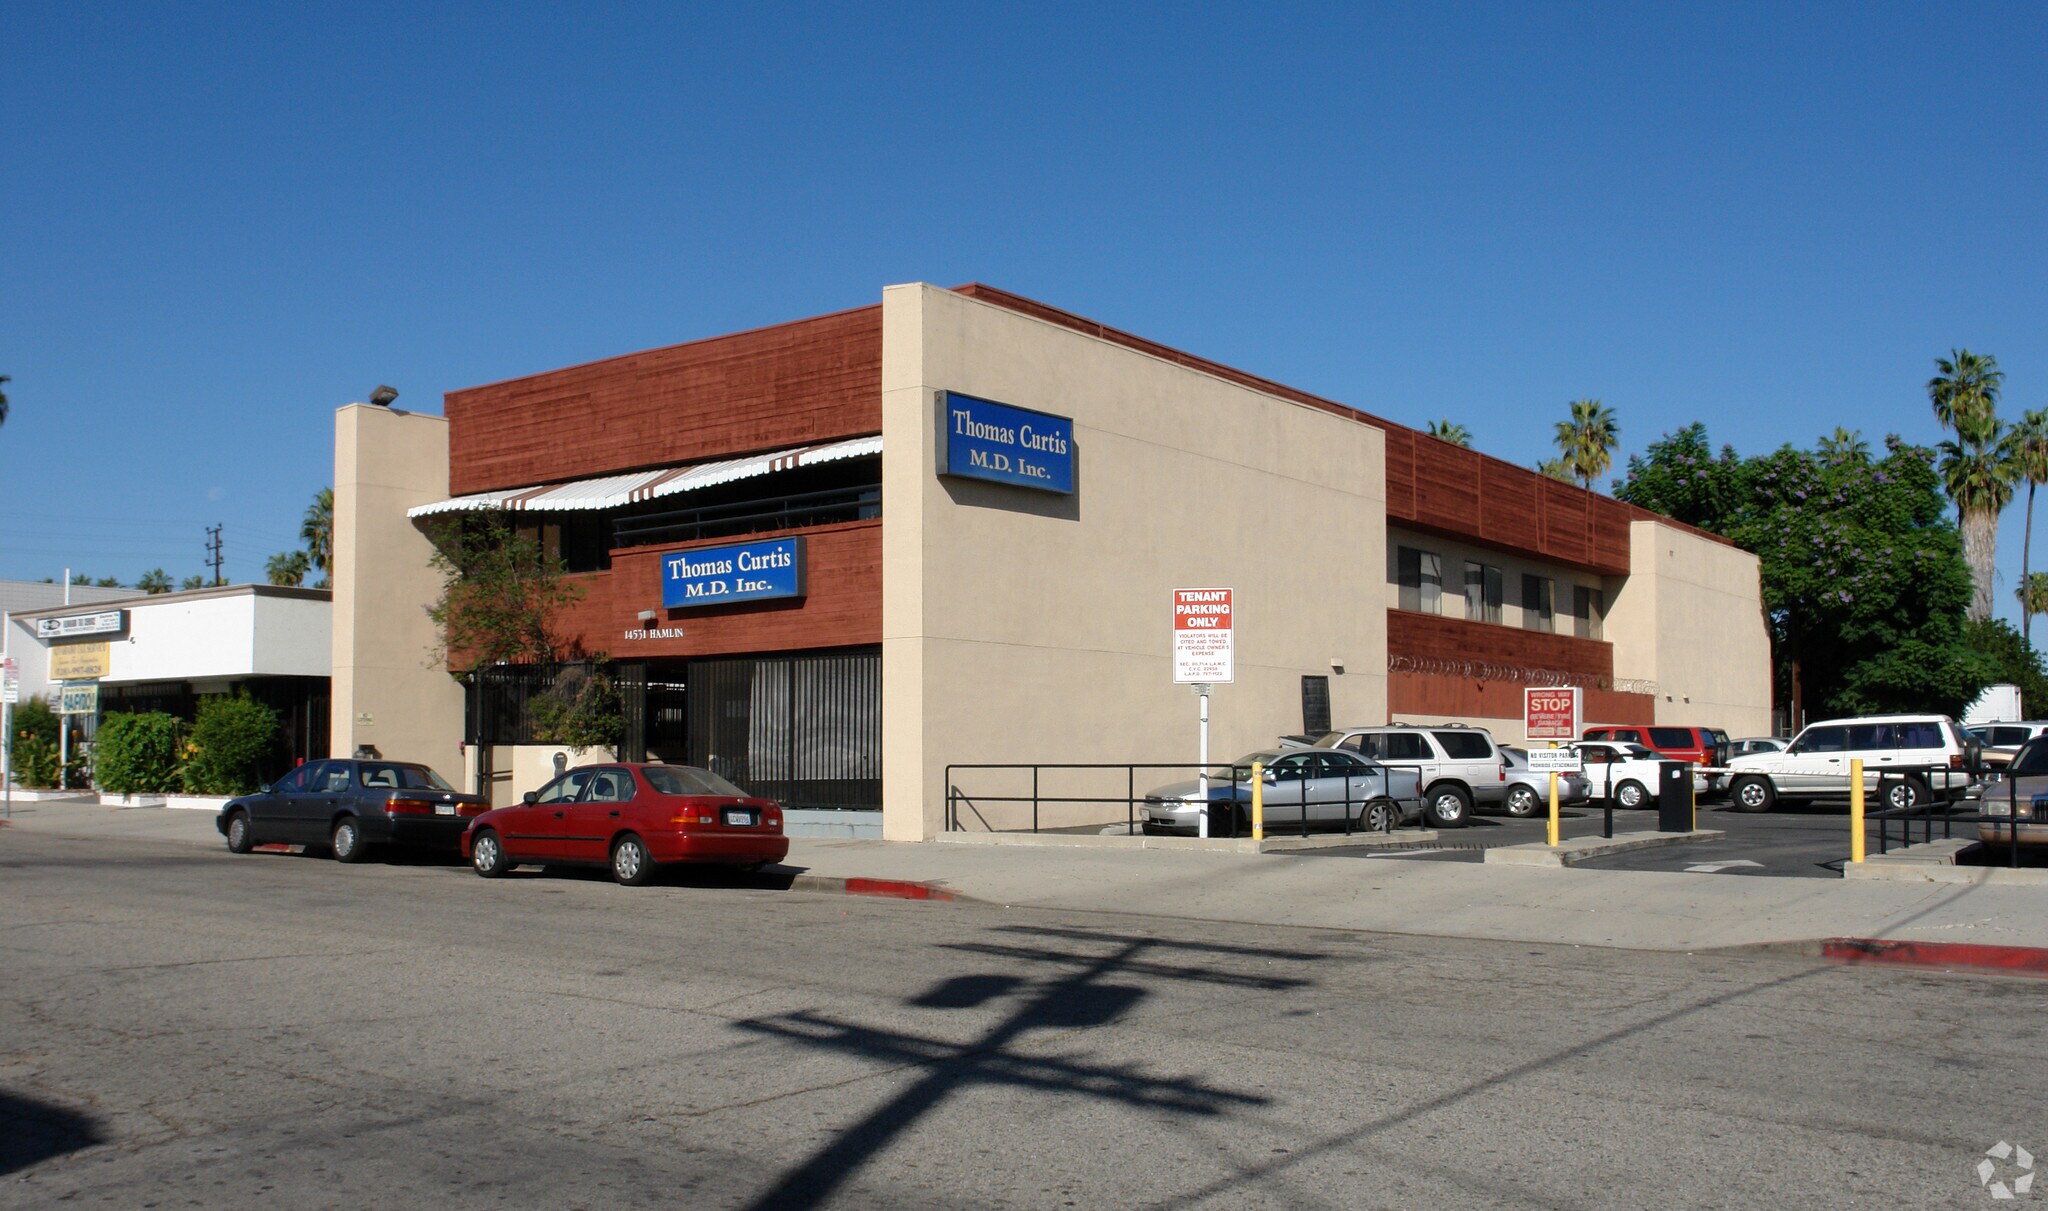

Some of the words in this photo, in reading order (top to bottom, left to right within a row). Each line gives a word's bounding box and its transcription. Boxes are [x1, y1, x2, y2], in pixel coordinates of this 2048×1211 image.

[952, 409, 1015, 445] Thomas
[1020, 425, 1067, 455] Curtis
[969, 448, 1013, 473] M.D.
[1018, 458, 1051, 480] Inc.
[668, 557, 733, 580] Thomas
[737, 546, 791, 572] Curtis
[685, 580, 730, 598] M.D.
[735, 578, 773, 593] Inc.
[1179, 591, 1227, 602] TENANT
[1176, 604, 1230, 614] PARKING
[1187, 617, 1218, 627] ONLY
[624, 629, 647, 640] 14531
[649, 628, 684, 639] HAMLIN
[1530, 698, 1571, 711] STOP
